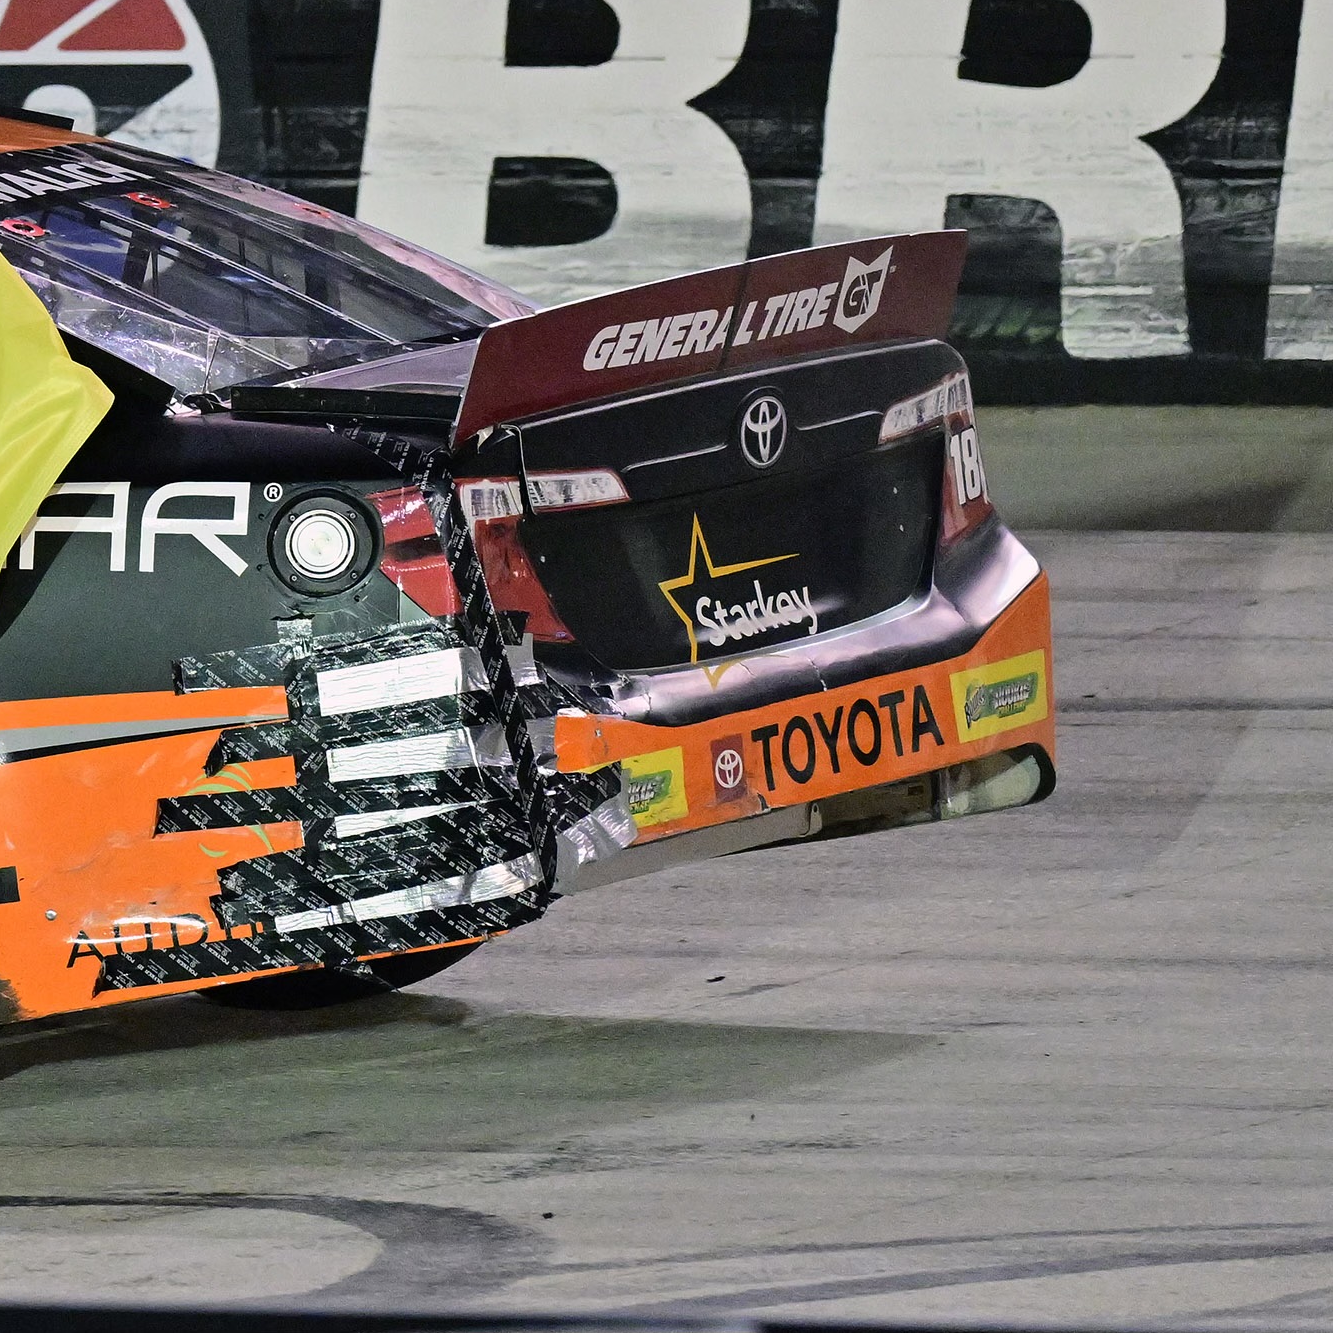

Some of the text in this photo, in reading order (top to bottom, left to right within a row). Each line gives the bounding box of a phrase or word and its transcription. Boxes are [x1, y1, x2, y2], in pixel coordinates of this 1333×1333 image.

[583, 300, 758, 371] GENERAL
[757, 282, 839, 341] TIRE
[949, 427, 983, 505] 18
[696, 580, 818, 647] Starkey
[751, 684, 945, 792] TOYOTA
